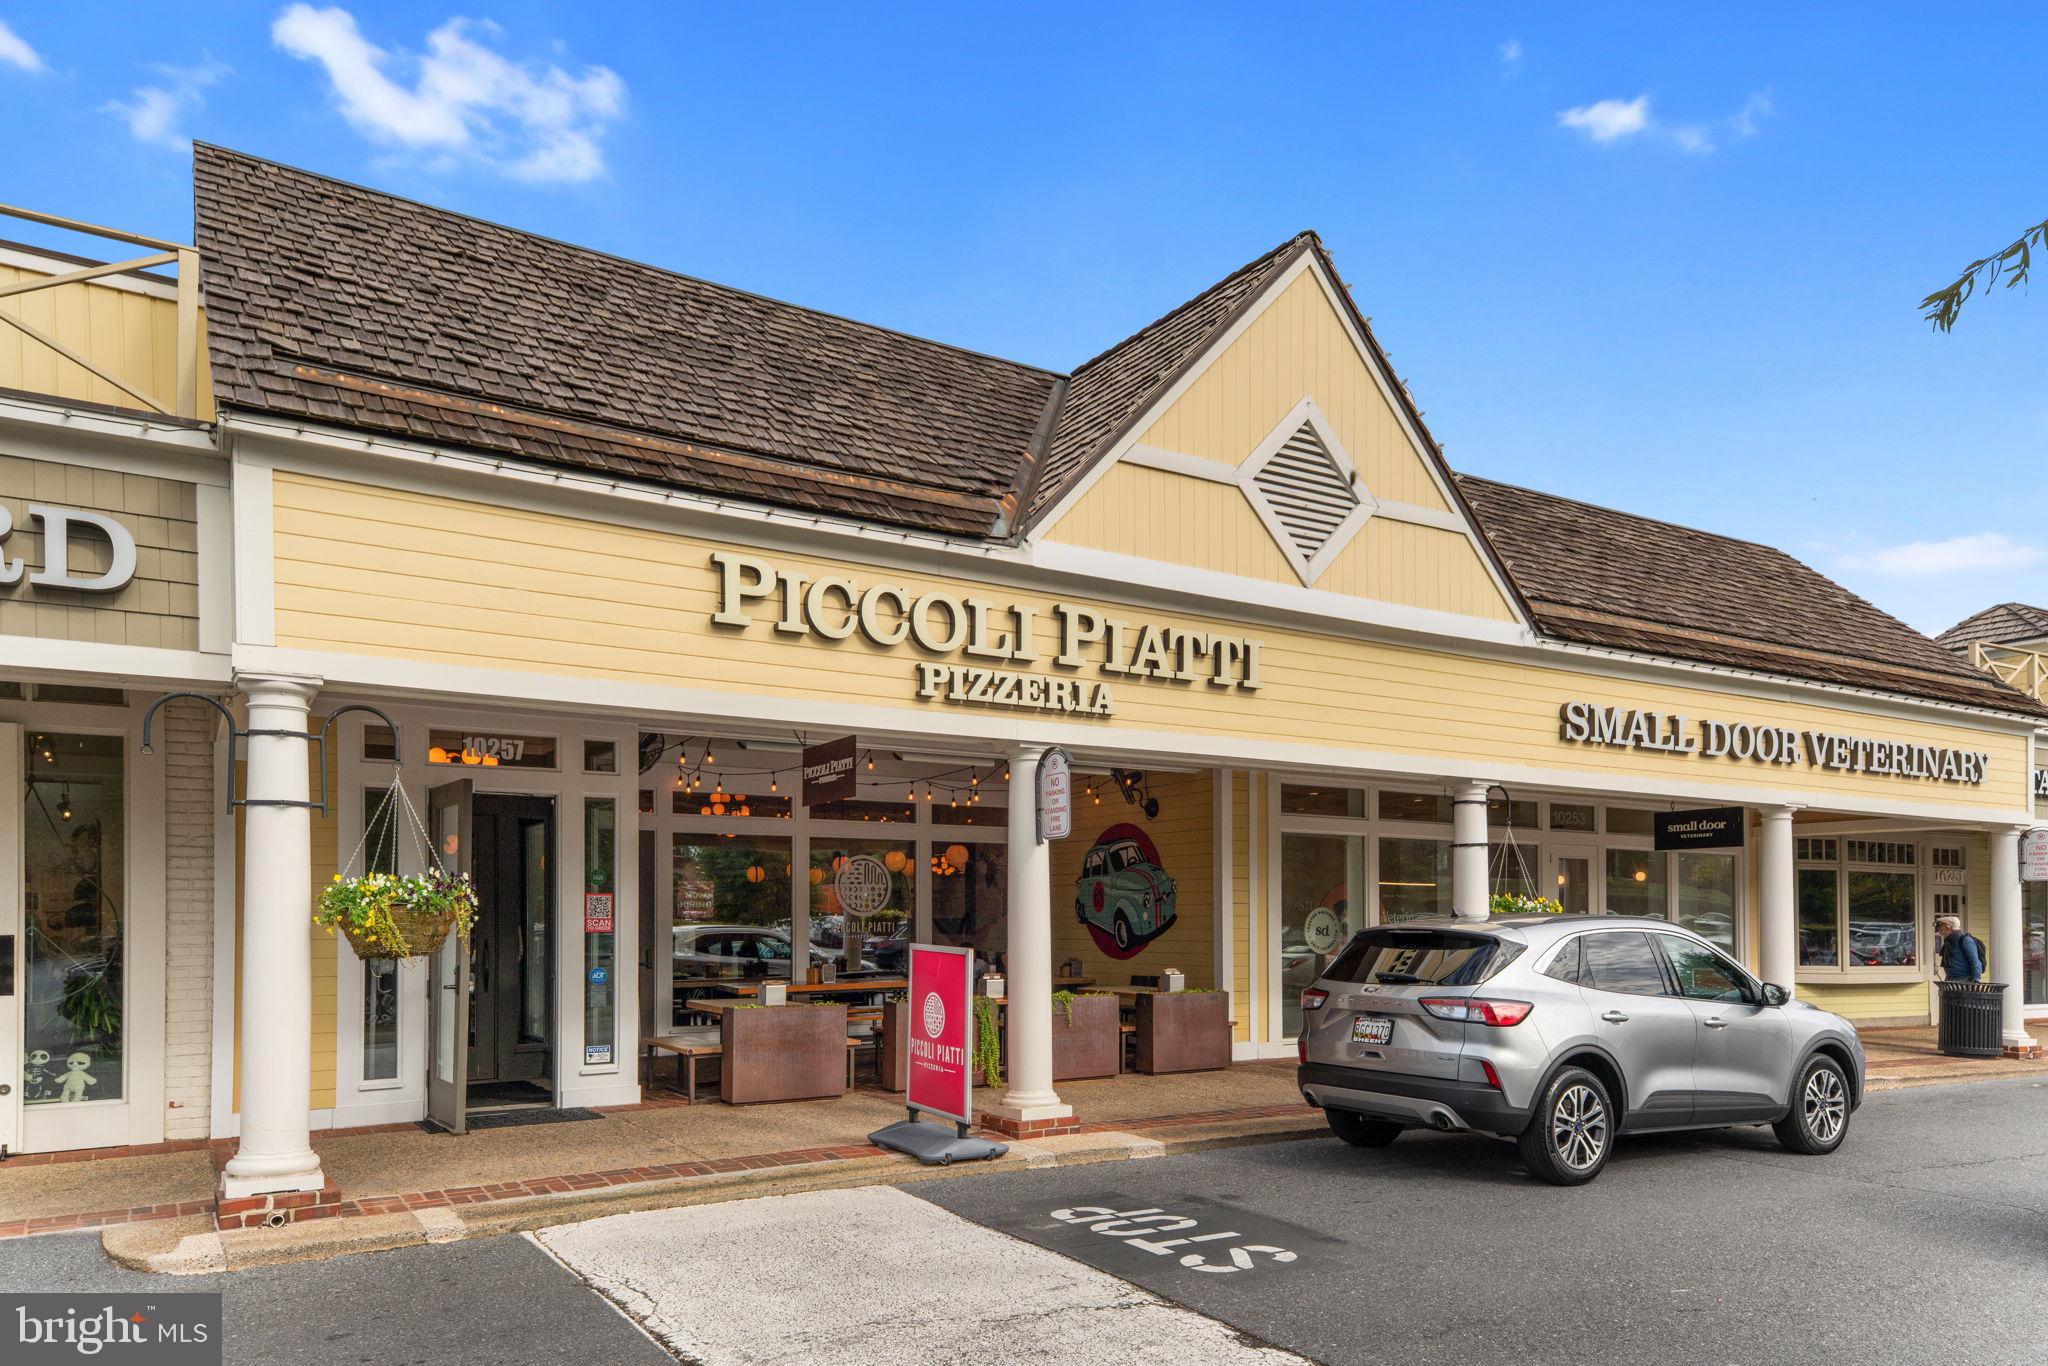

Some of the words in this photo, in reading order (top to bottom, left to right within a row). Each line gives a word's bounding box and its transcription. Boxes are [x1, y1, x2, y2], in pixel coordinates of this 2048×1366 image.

[0, 503, 137, 592] D
[711, 551, 1040, 662] PICCOLI
[1054, 603, 1265, 690] PIATTI
[916, 662, 1116, 716] PIZZERIA
[463, 736, 524, 761] 10257
[1560, 702, 1696, 754] SMALL
[1700, 719, 1802, 765] DOOR
[1804, 731, 1989, 785] VETERINARY
[803, 762, 830, 780] PICCOLI
[830, 756, 854, 773] PIATTI
[1050, 777, 1060, 787] NO
[1045, 788, 1066, 798] PARKING
[1044, 805, 1067, 815] STANDING
[1050, 815, 1061, 823] FIRE
[1553, 810, 1586, 826] 10253
[1049, 824, 1062, 832] LANE
[1667, 820, 1698, 833] small
[1698, 819, 1727, 830] door
[1935, 869, 1964, 883] 10251
[868, 921, 896, 933] PIATTI
[1315, 924, 1330, 937] sd
[587, 1045, 609, 1053] NOTICE
[911, 1037, 935, 1060] PICCOLI
[937, 1043, 964, 1066] PIATTI
[923, 1061, 944, 1073] PIZZERIA
[1050, 1206, 1298, 1273] STOP
